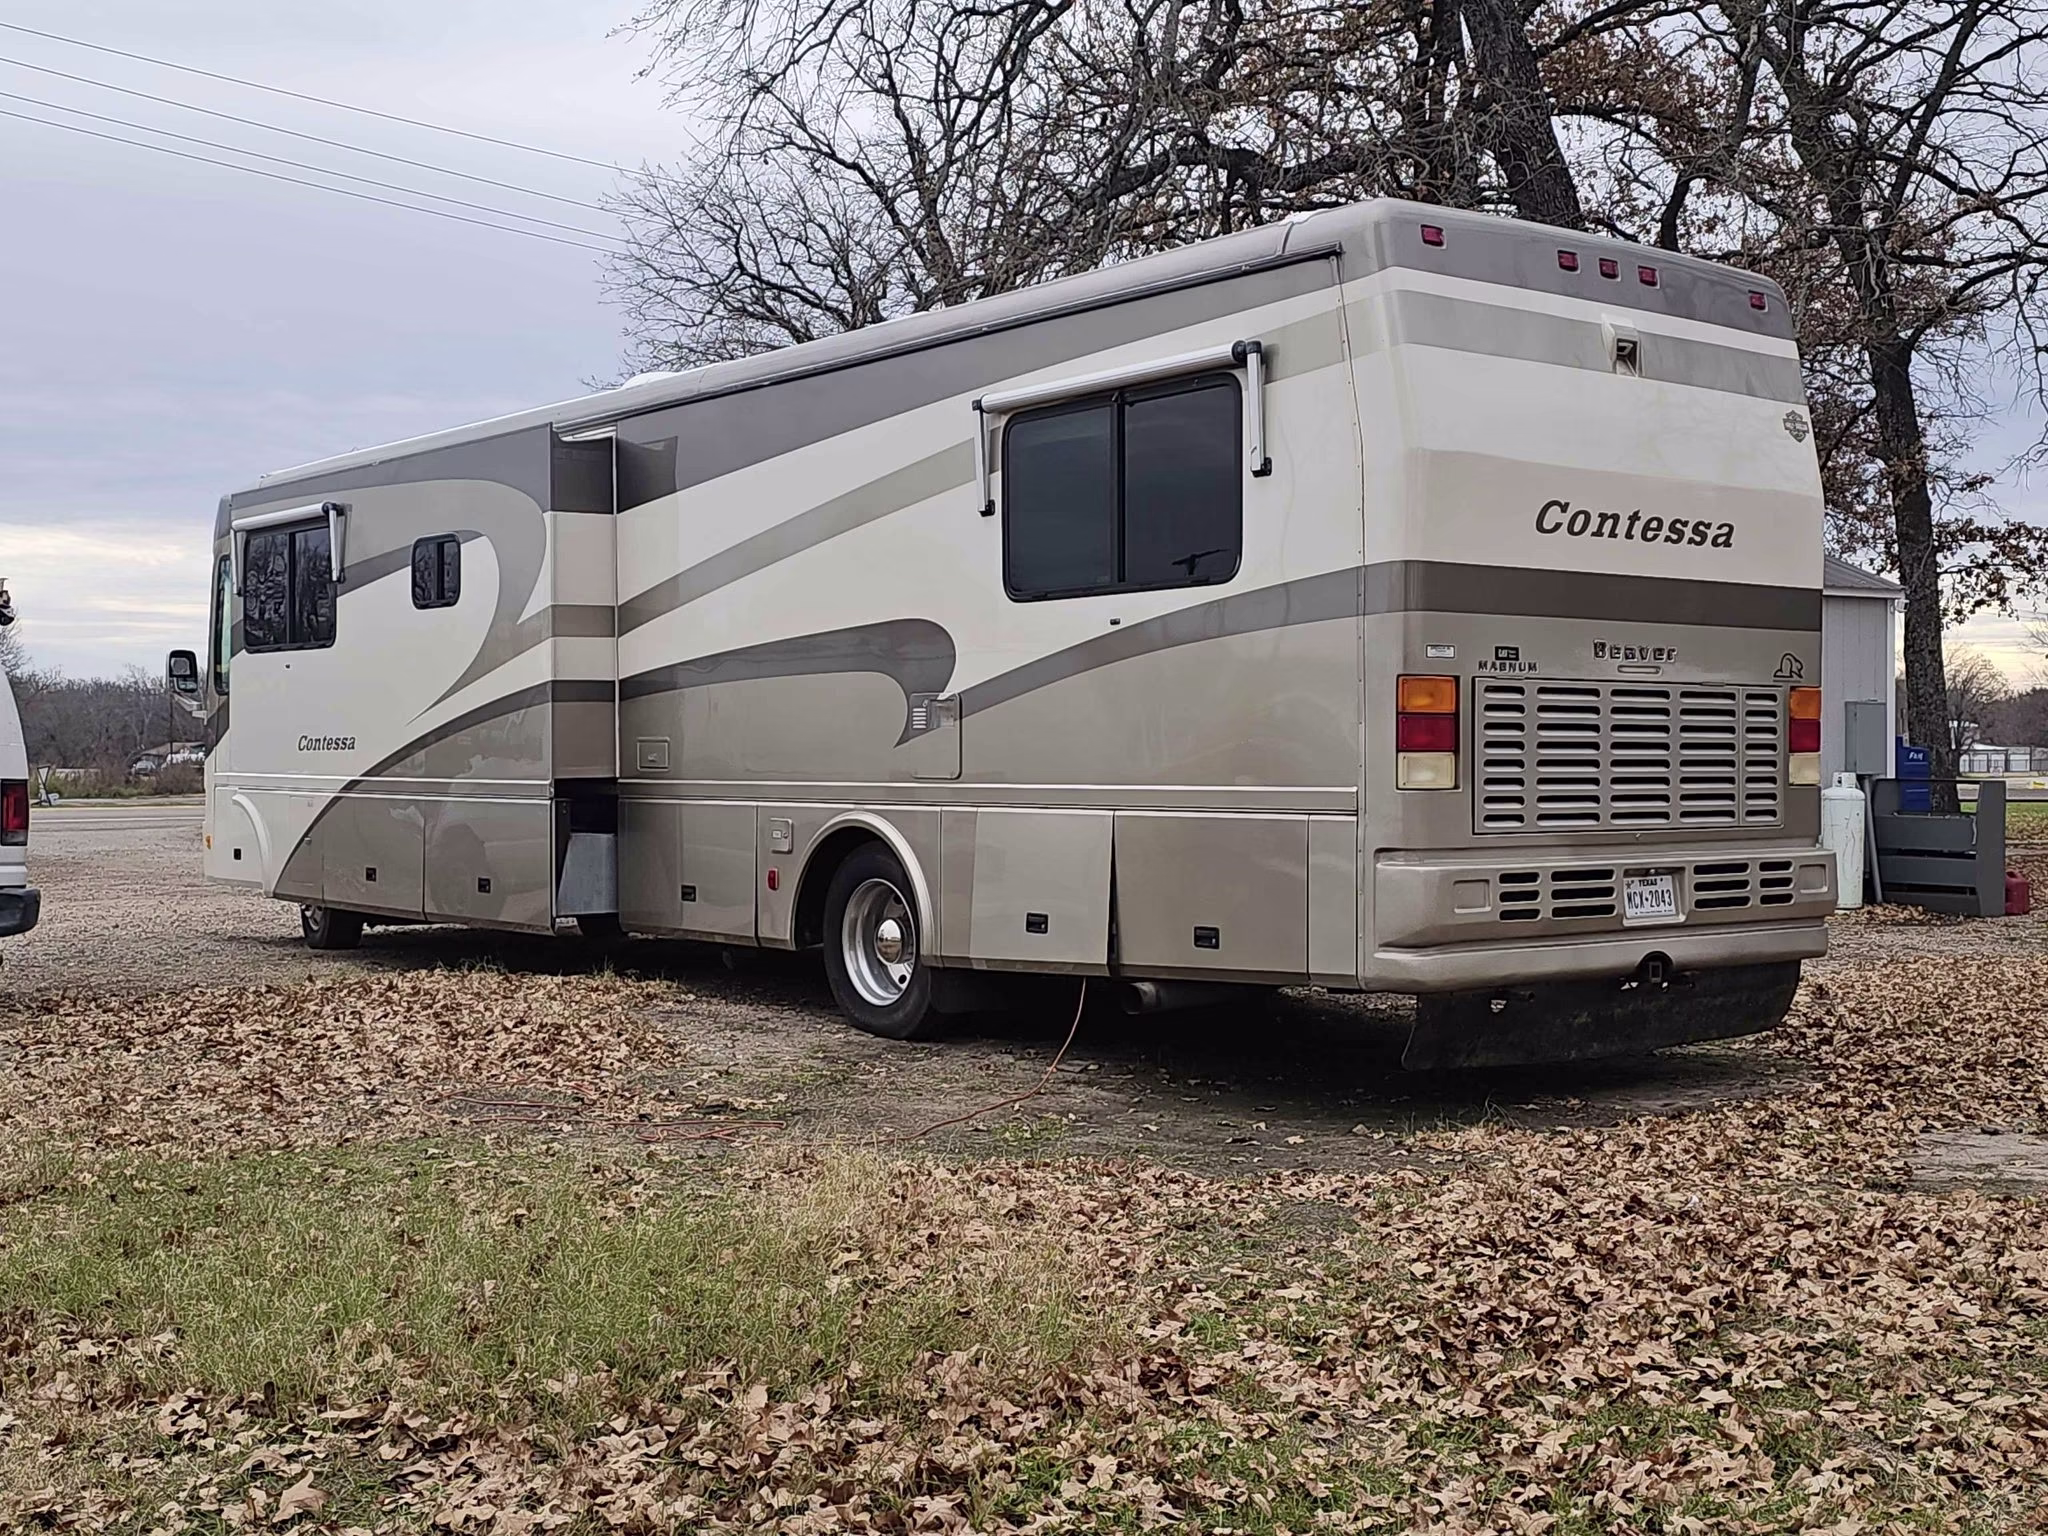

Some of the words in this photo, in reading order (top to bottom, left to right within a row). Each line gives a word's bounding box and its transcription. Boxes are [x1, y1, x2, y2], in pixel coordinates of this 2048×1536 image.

[1535, 499, 1735, 549] Contessa
[1593, 640, 1677, 662] Beaver
[1478, 660, 1538, 673] MAGNUM
[298, 734, 356, 751] Contessa
